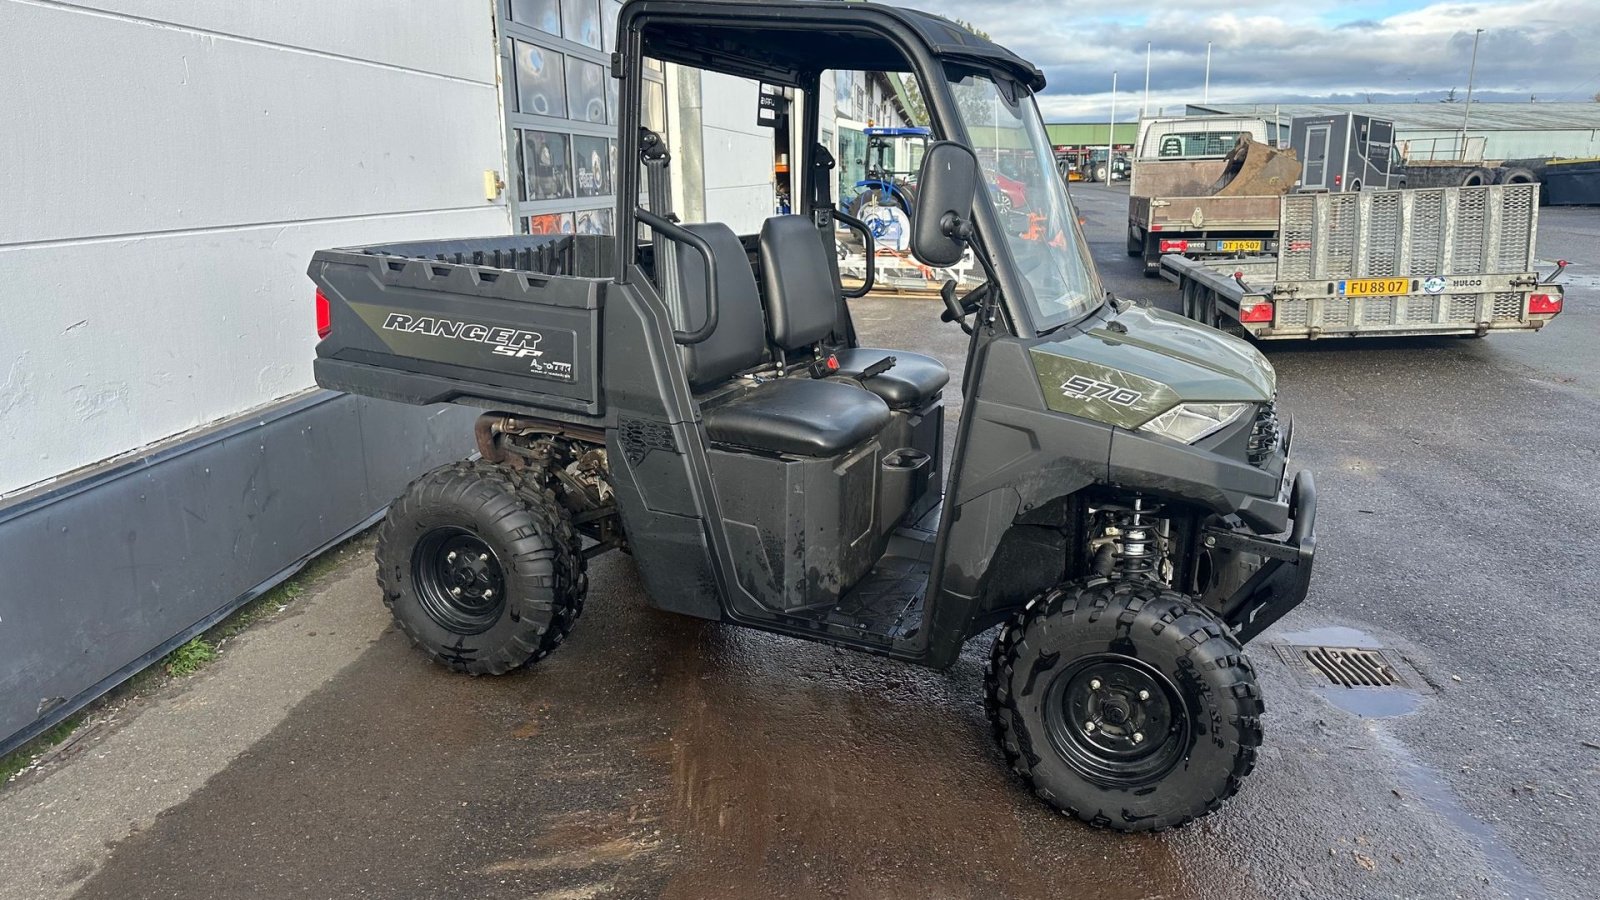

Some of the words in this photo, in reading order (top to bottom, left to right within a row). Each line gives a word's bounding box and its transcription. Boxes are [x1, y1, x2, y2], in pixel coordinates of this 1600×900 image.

[1351, 282, 1368, 294] FU
[1370, 281, 1385, 293] 88
[1388, 281, 1403, 293] 07
[382, 312, 543, 350] RANGER
[491, 344, 544, 358] SP
[1060, 374, 1143, 407] 570
